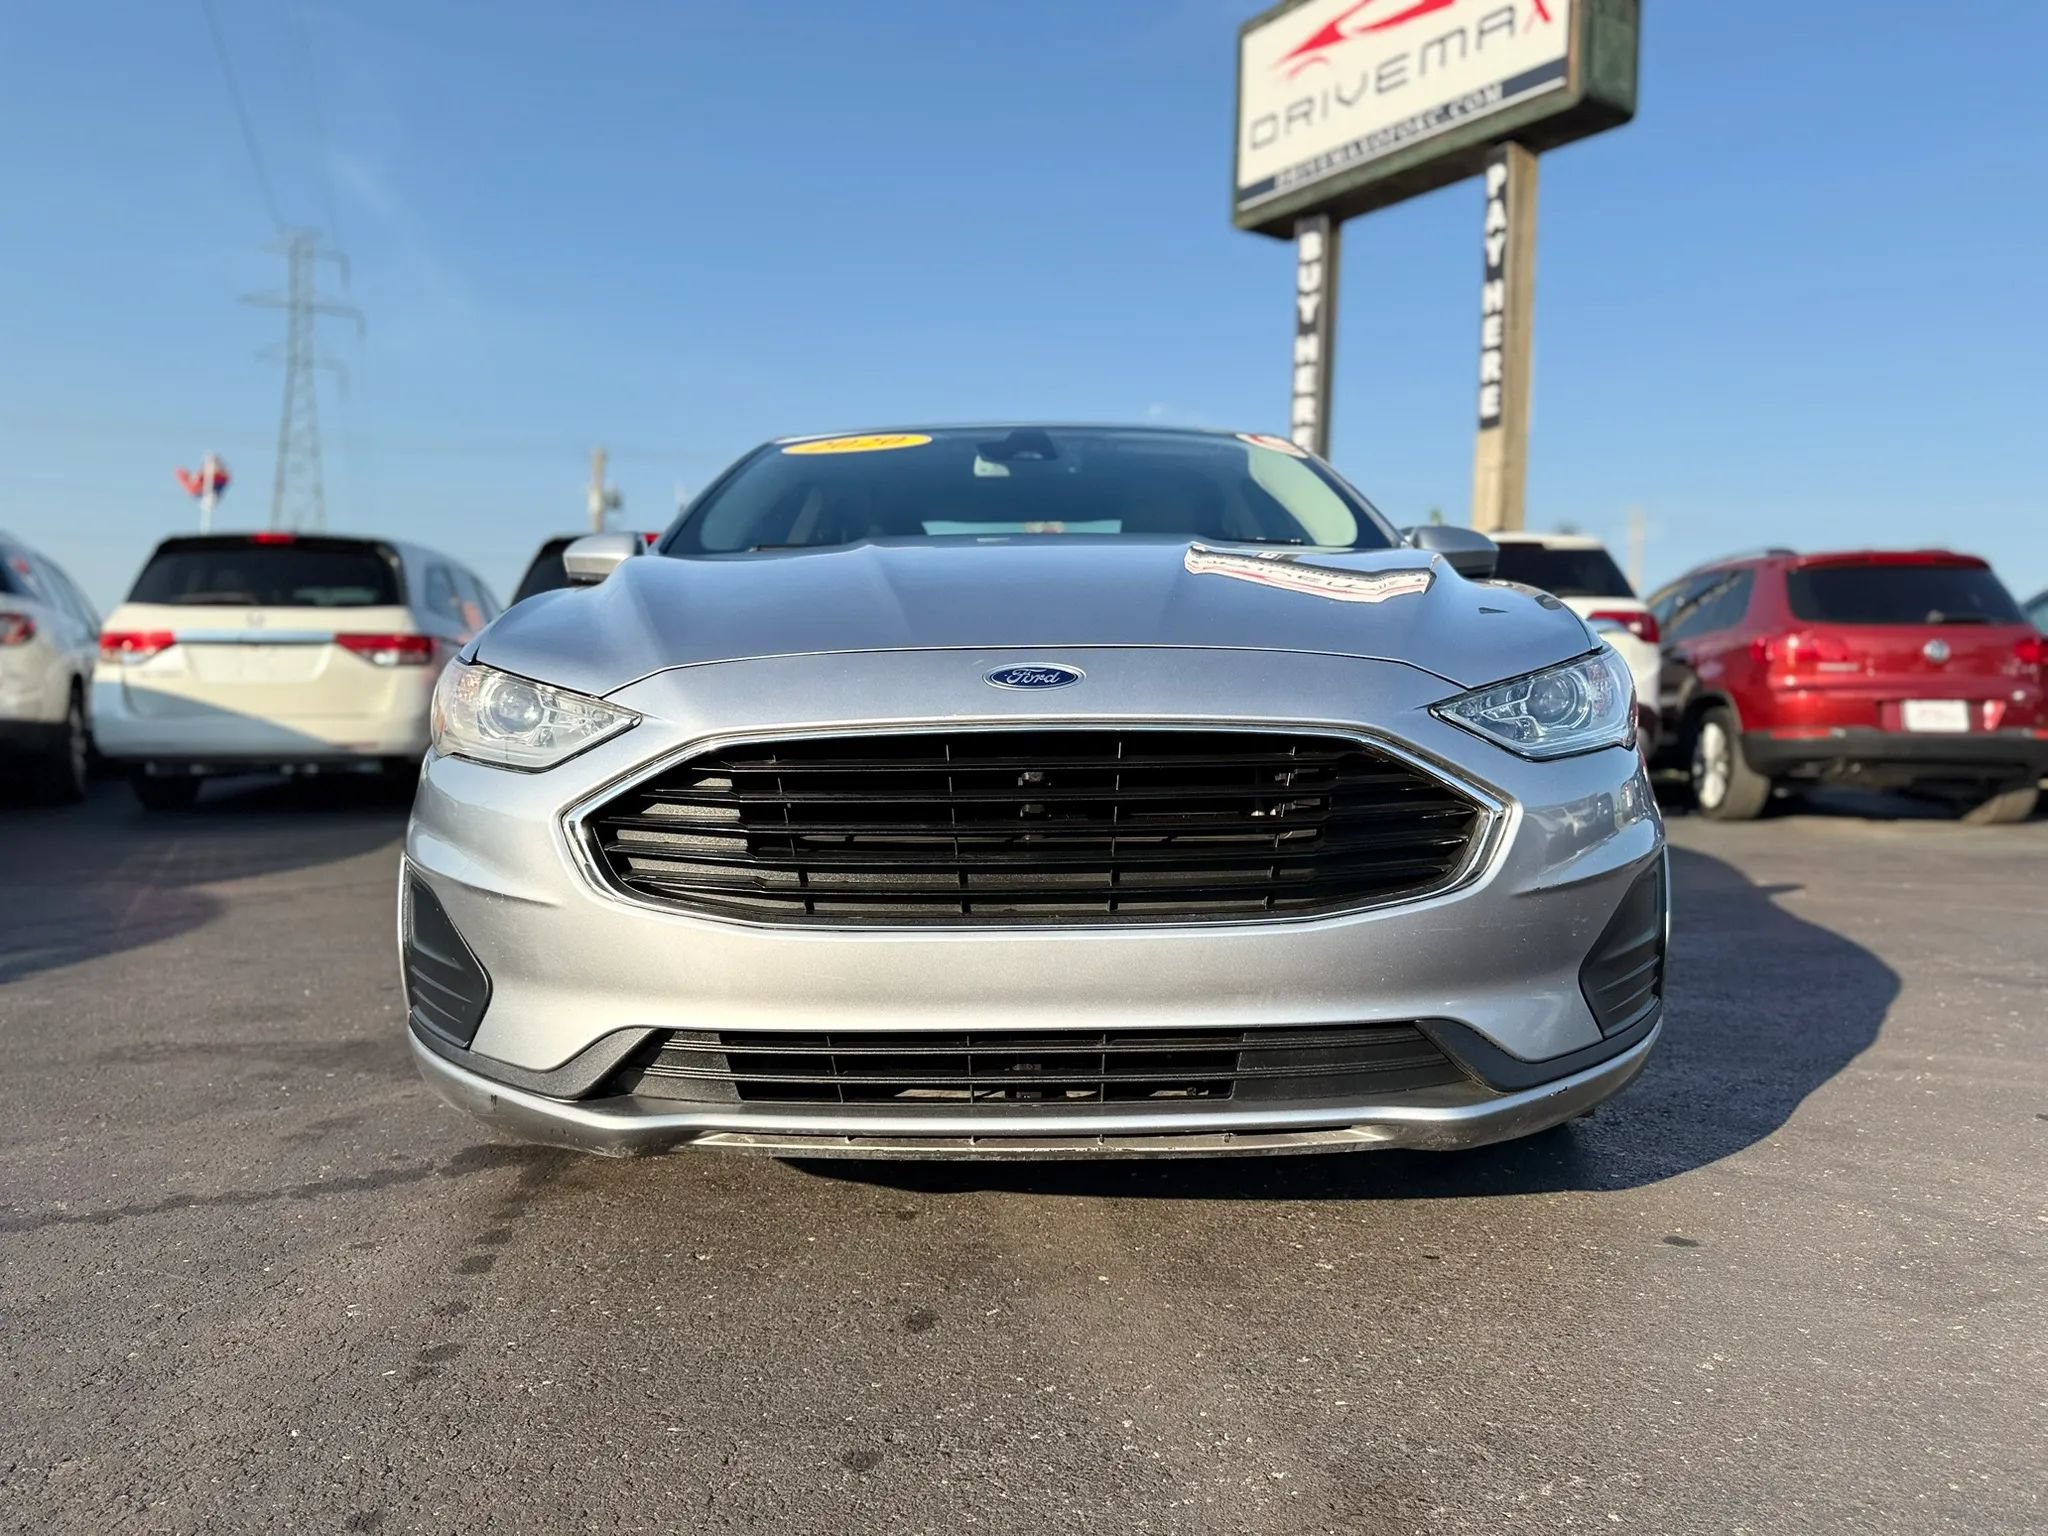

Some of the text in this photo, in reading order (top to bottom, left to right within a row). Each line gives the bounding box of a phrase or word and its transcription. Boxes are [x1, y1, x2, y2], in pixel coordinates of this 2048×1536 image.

[1297, 231, 1322, 324] BUY
[1479, 162, 1507, 418] PAY HERE
[1005, 668, 1061, 684] Ford
